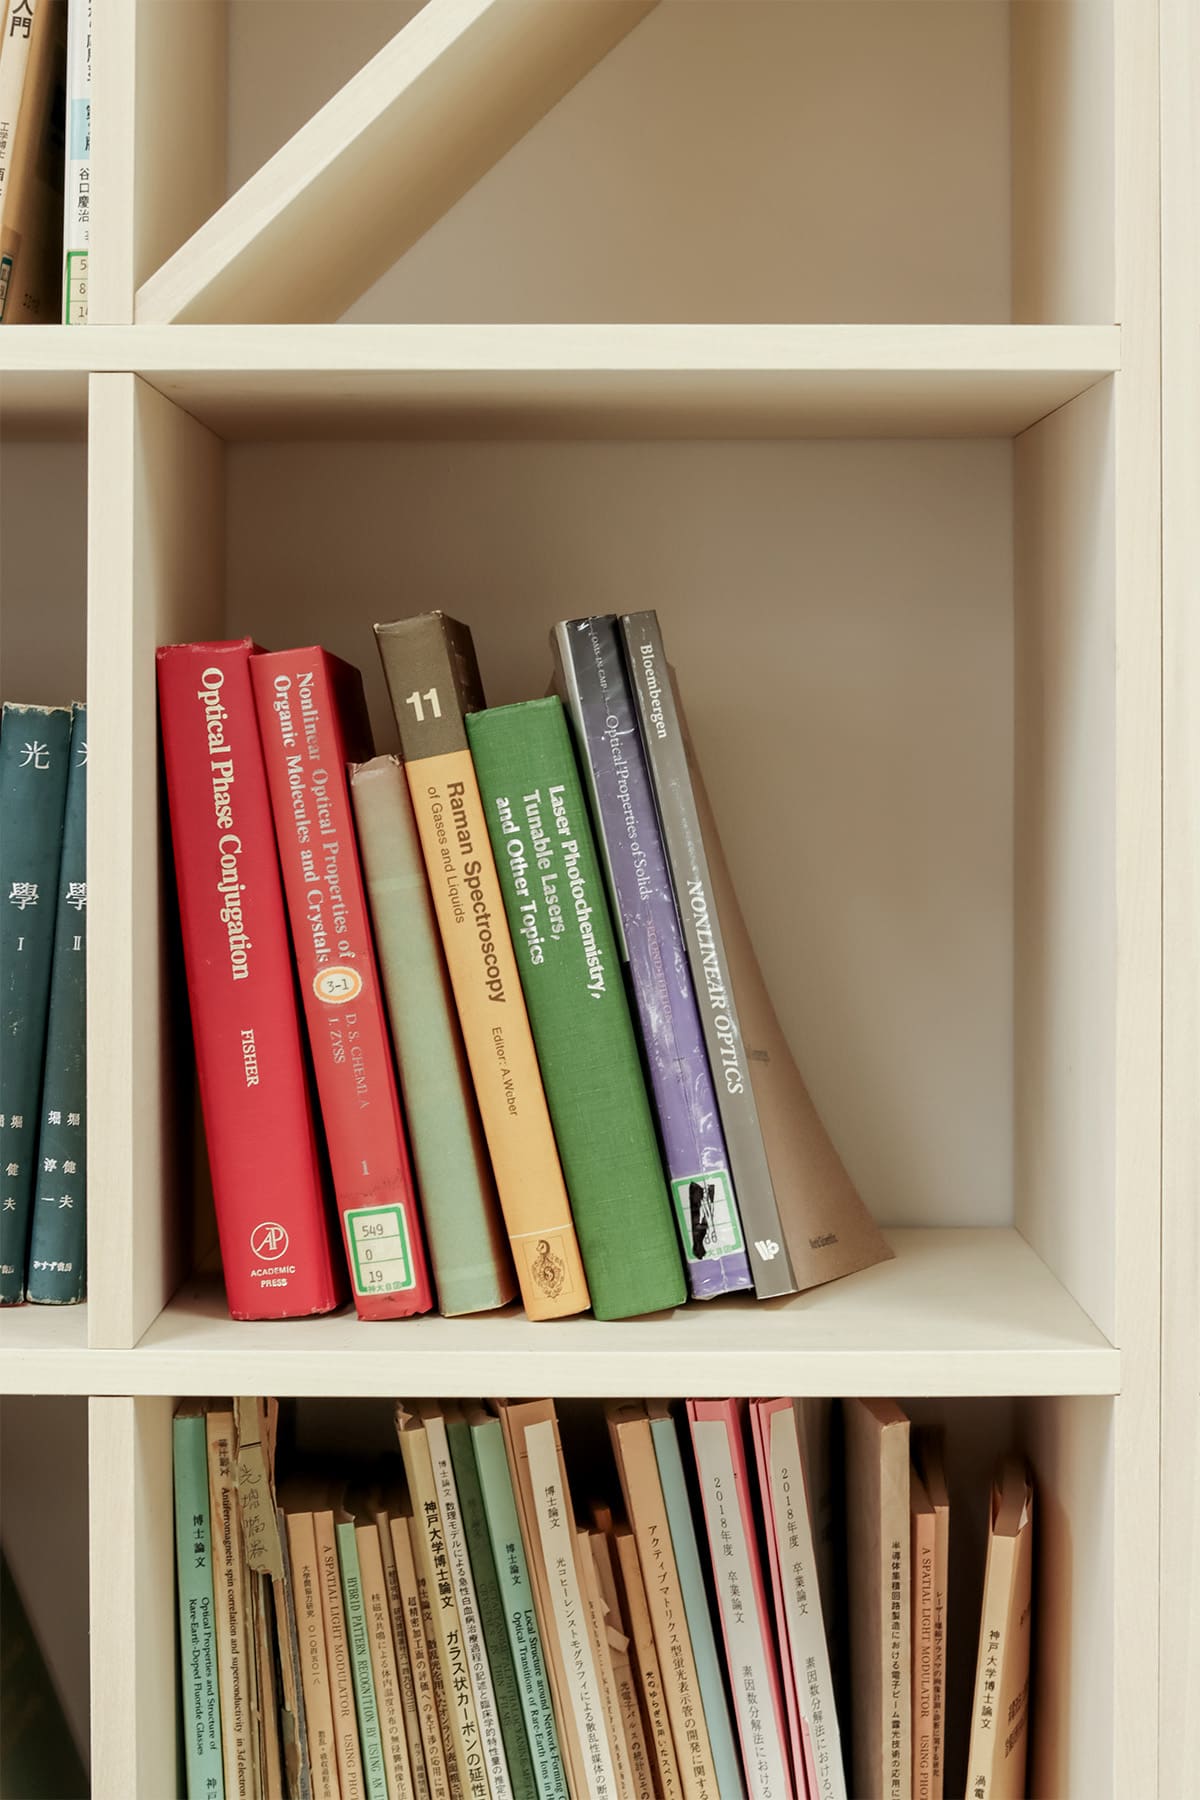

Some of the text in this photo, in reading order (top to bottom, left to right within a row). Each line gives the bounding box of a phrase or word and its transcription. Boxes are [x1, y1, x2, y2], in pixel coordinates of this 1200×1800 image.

[406, 687, 442, 722] 11
[639, 644, 667, 739] Bloembergen
[197, 667, 253, 981] Optical Phase Conjugation
[273, 675, 332, 963] Organic Molecules and Crystals
[296, 672, 356, 959] Nonlinear Optical Properties of
[605, 714, 653, 901] Optical Properties of Solids
[428, 786, 465, 925] of Gases and Liquids
[523, 789, 566, 941] Tunable Lasers,
[447, 781, 507, 1004] Raman Spectroscopy
[496, 797, 545, 966] and Other Topics
[548, 785, 606, 1000] Laser Photochemistry,
[326, 978, 350, 992] 3-1
[686, 879, 744, 1095] NONLINEAR OPTICS
[240, 1029, 259, 1087] FISHER
[331, 1031, 346, 1065] ZYSS
[492, 1026, 506, 1066] Editor:
[361, 1223, 385, 1238] 549
[251, 1266, 296, 1278] ACADEMIC
[260, 1278, 288, 1289] PRESS
[369, 1270, 384, 1284] 19
[438, 1460, 451, 1497] 博士論文
[544, 1485, 561, 1529] 博士論文
[323, 1545, 332, 1553] A
[423, 1501, 455, 1610] 神戸大学博士論文
[713, 1477, 735, 1557] 2018年度
[727, 1570, 745, 1625] 卒業論文
[781, 1467, 800, 1549] 2018年度
[792, 1561, 809, 1616] 卒業論文
[922, 1547, 931, 1557] A
[325, 1555, 338, 1604] SPATIAL
[505, 1543, 522, 1585] 博士論文
[921, 1558, 932, 1608] SPATIAL
[347, 1577, 359, 1613] HYBRID
[221, 1487, 247, 1797] Antiferromagnetic spin correlation and superconductivity in 3d electron
[329, 1605, 343, 1641] LIGHT
[350, 1614, 365, 1656] PATTERN
[512, 1612, 526, 1644] Optical
[523, 1609, 537, 1635] Local
[921, 1610, 931, 1644] LIGHT
[200, 1597, 218, 1750] Optical Properties and Structure of
[519, 1648, 534, 1695] Transitions
[529, 1637, 543, 1676] Structure
[334, 1643, 350, 1718] MODULATOR
[358, 1657, 374, 1723] RECOGNITION
[537, 1680, 549, 1711] around
[920, 1646, 931, 1719] MODULATOR
[980, 1629, 1000, 1730] 神戸大学博士論文
[194, 1683, 205, 1719] Fluoride
[528, 1697, 537, 1706] of
[196, 1722, 206, 1756] Glasses
[343, 1734, 356, 1768] USING
[367, 1725, 377, 1736] BY
[531, 1710, 546, 1758] Rare-Earth
[645, 1671, 675, 1800] 光のゆらぎを用いたスペクト
[367, 1738, 381, 1771] USING
[540, 1760, 550, 1779] Ions
[543, 1713, 564, 1793] Network-Forming
[919, 1735, 930, 1772] USING
[372, 1773, 384, 1787] AN
[544, 1783, 552, 1791] in
